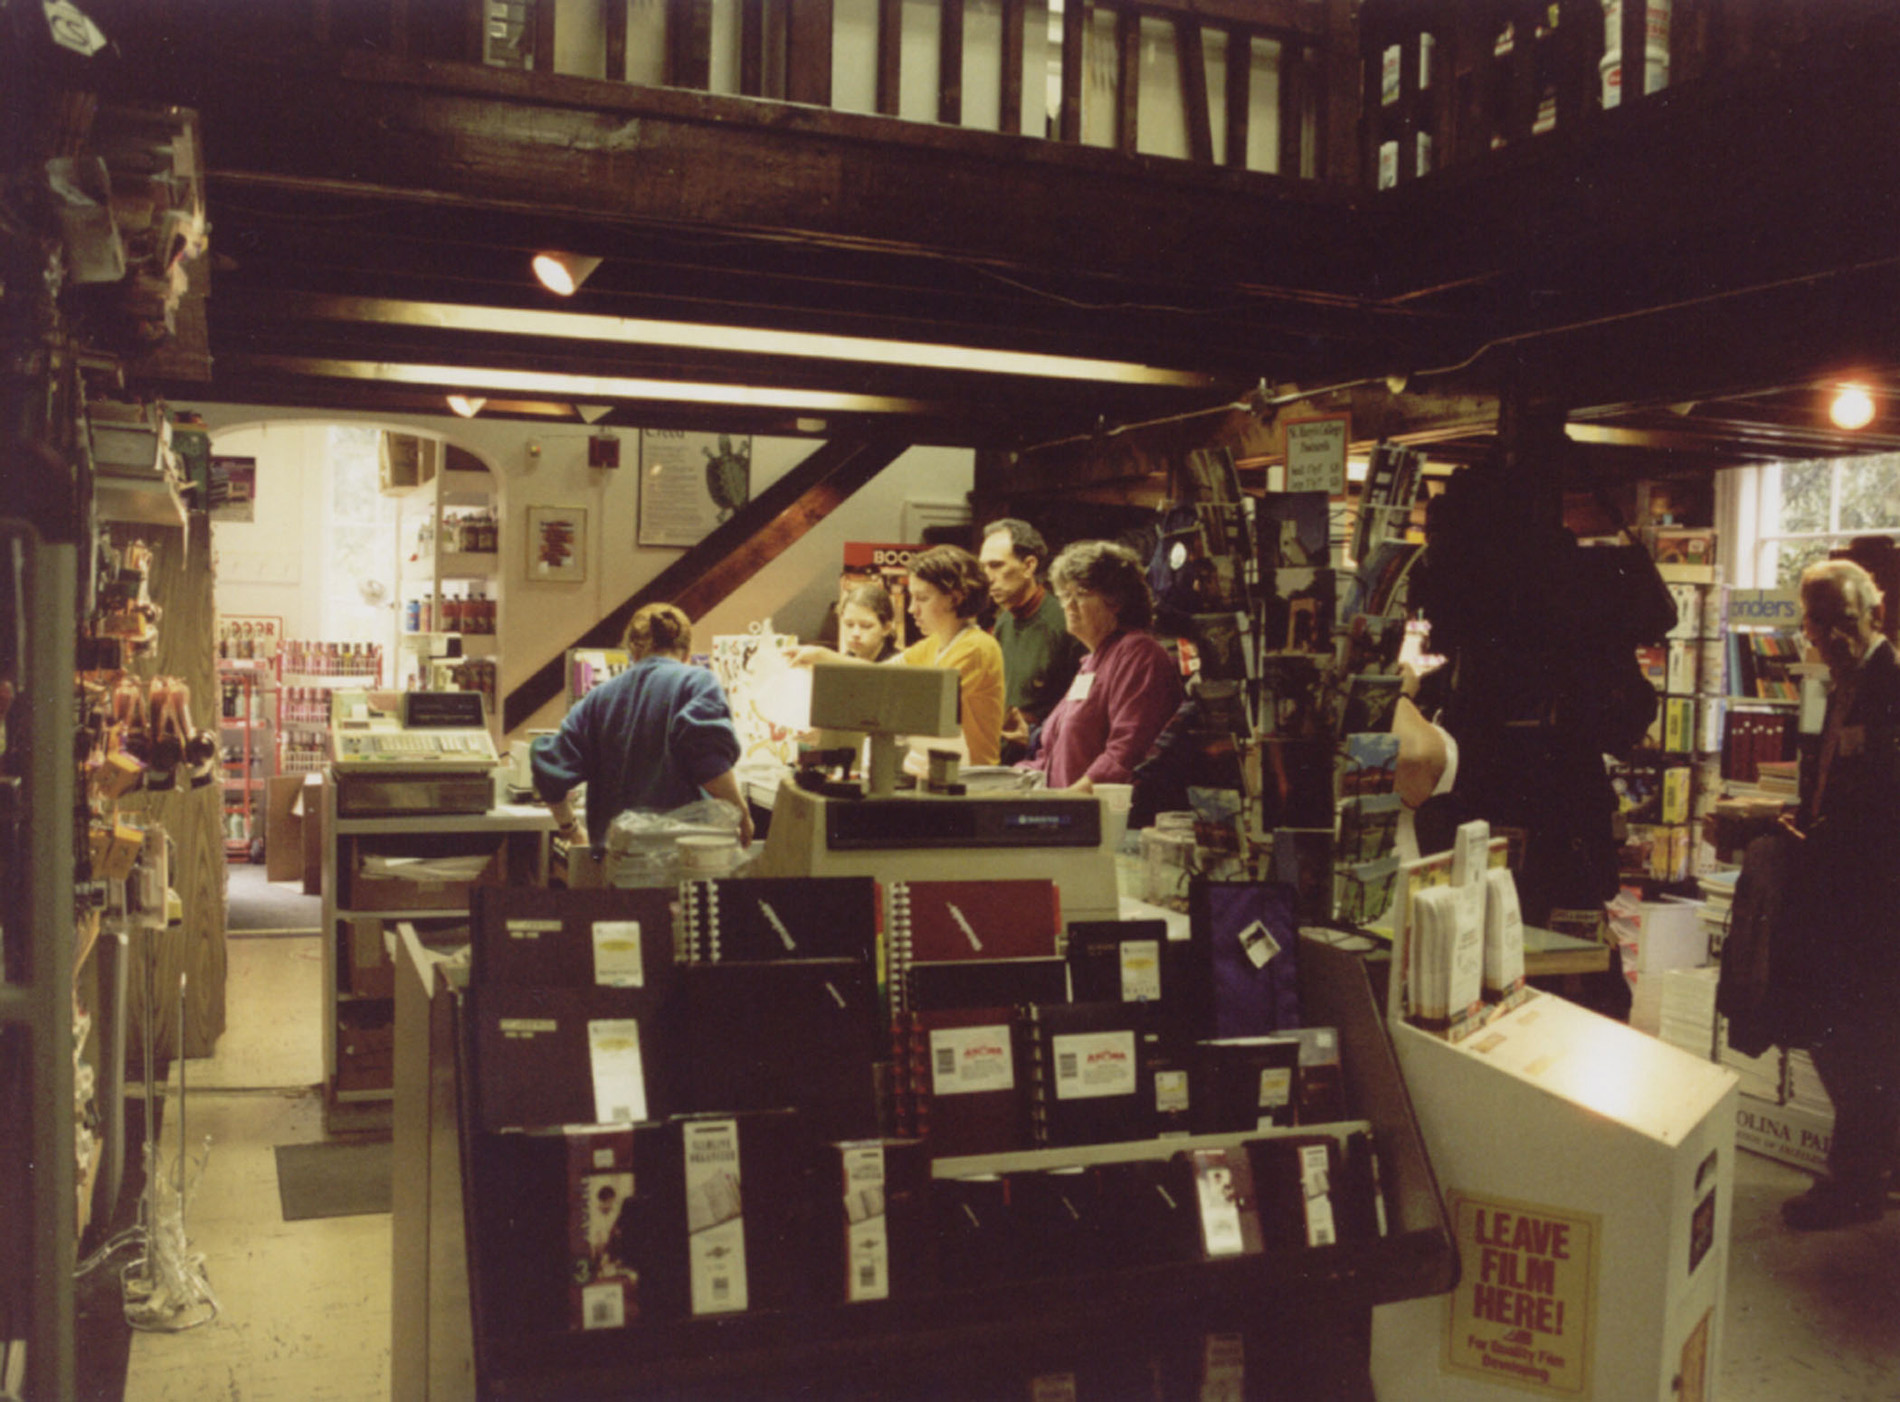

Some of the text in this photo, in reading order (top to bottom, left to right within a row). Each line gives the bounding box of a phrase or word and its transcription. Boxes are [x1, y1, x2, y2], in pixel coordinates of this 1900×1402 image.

[873, 549, 912, 566] BOO
[1736, 1109, 1791, 1142] OLINA
[1475, 1209, 1570, 1260] LEAVE
[1480, 1247, 1556, 1296] FILM
[1473, 1282, 1565, 1336] HERE!
